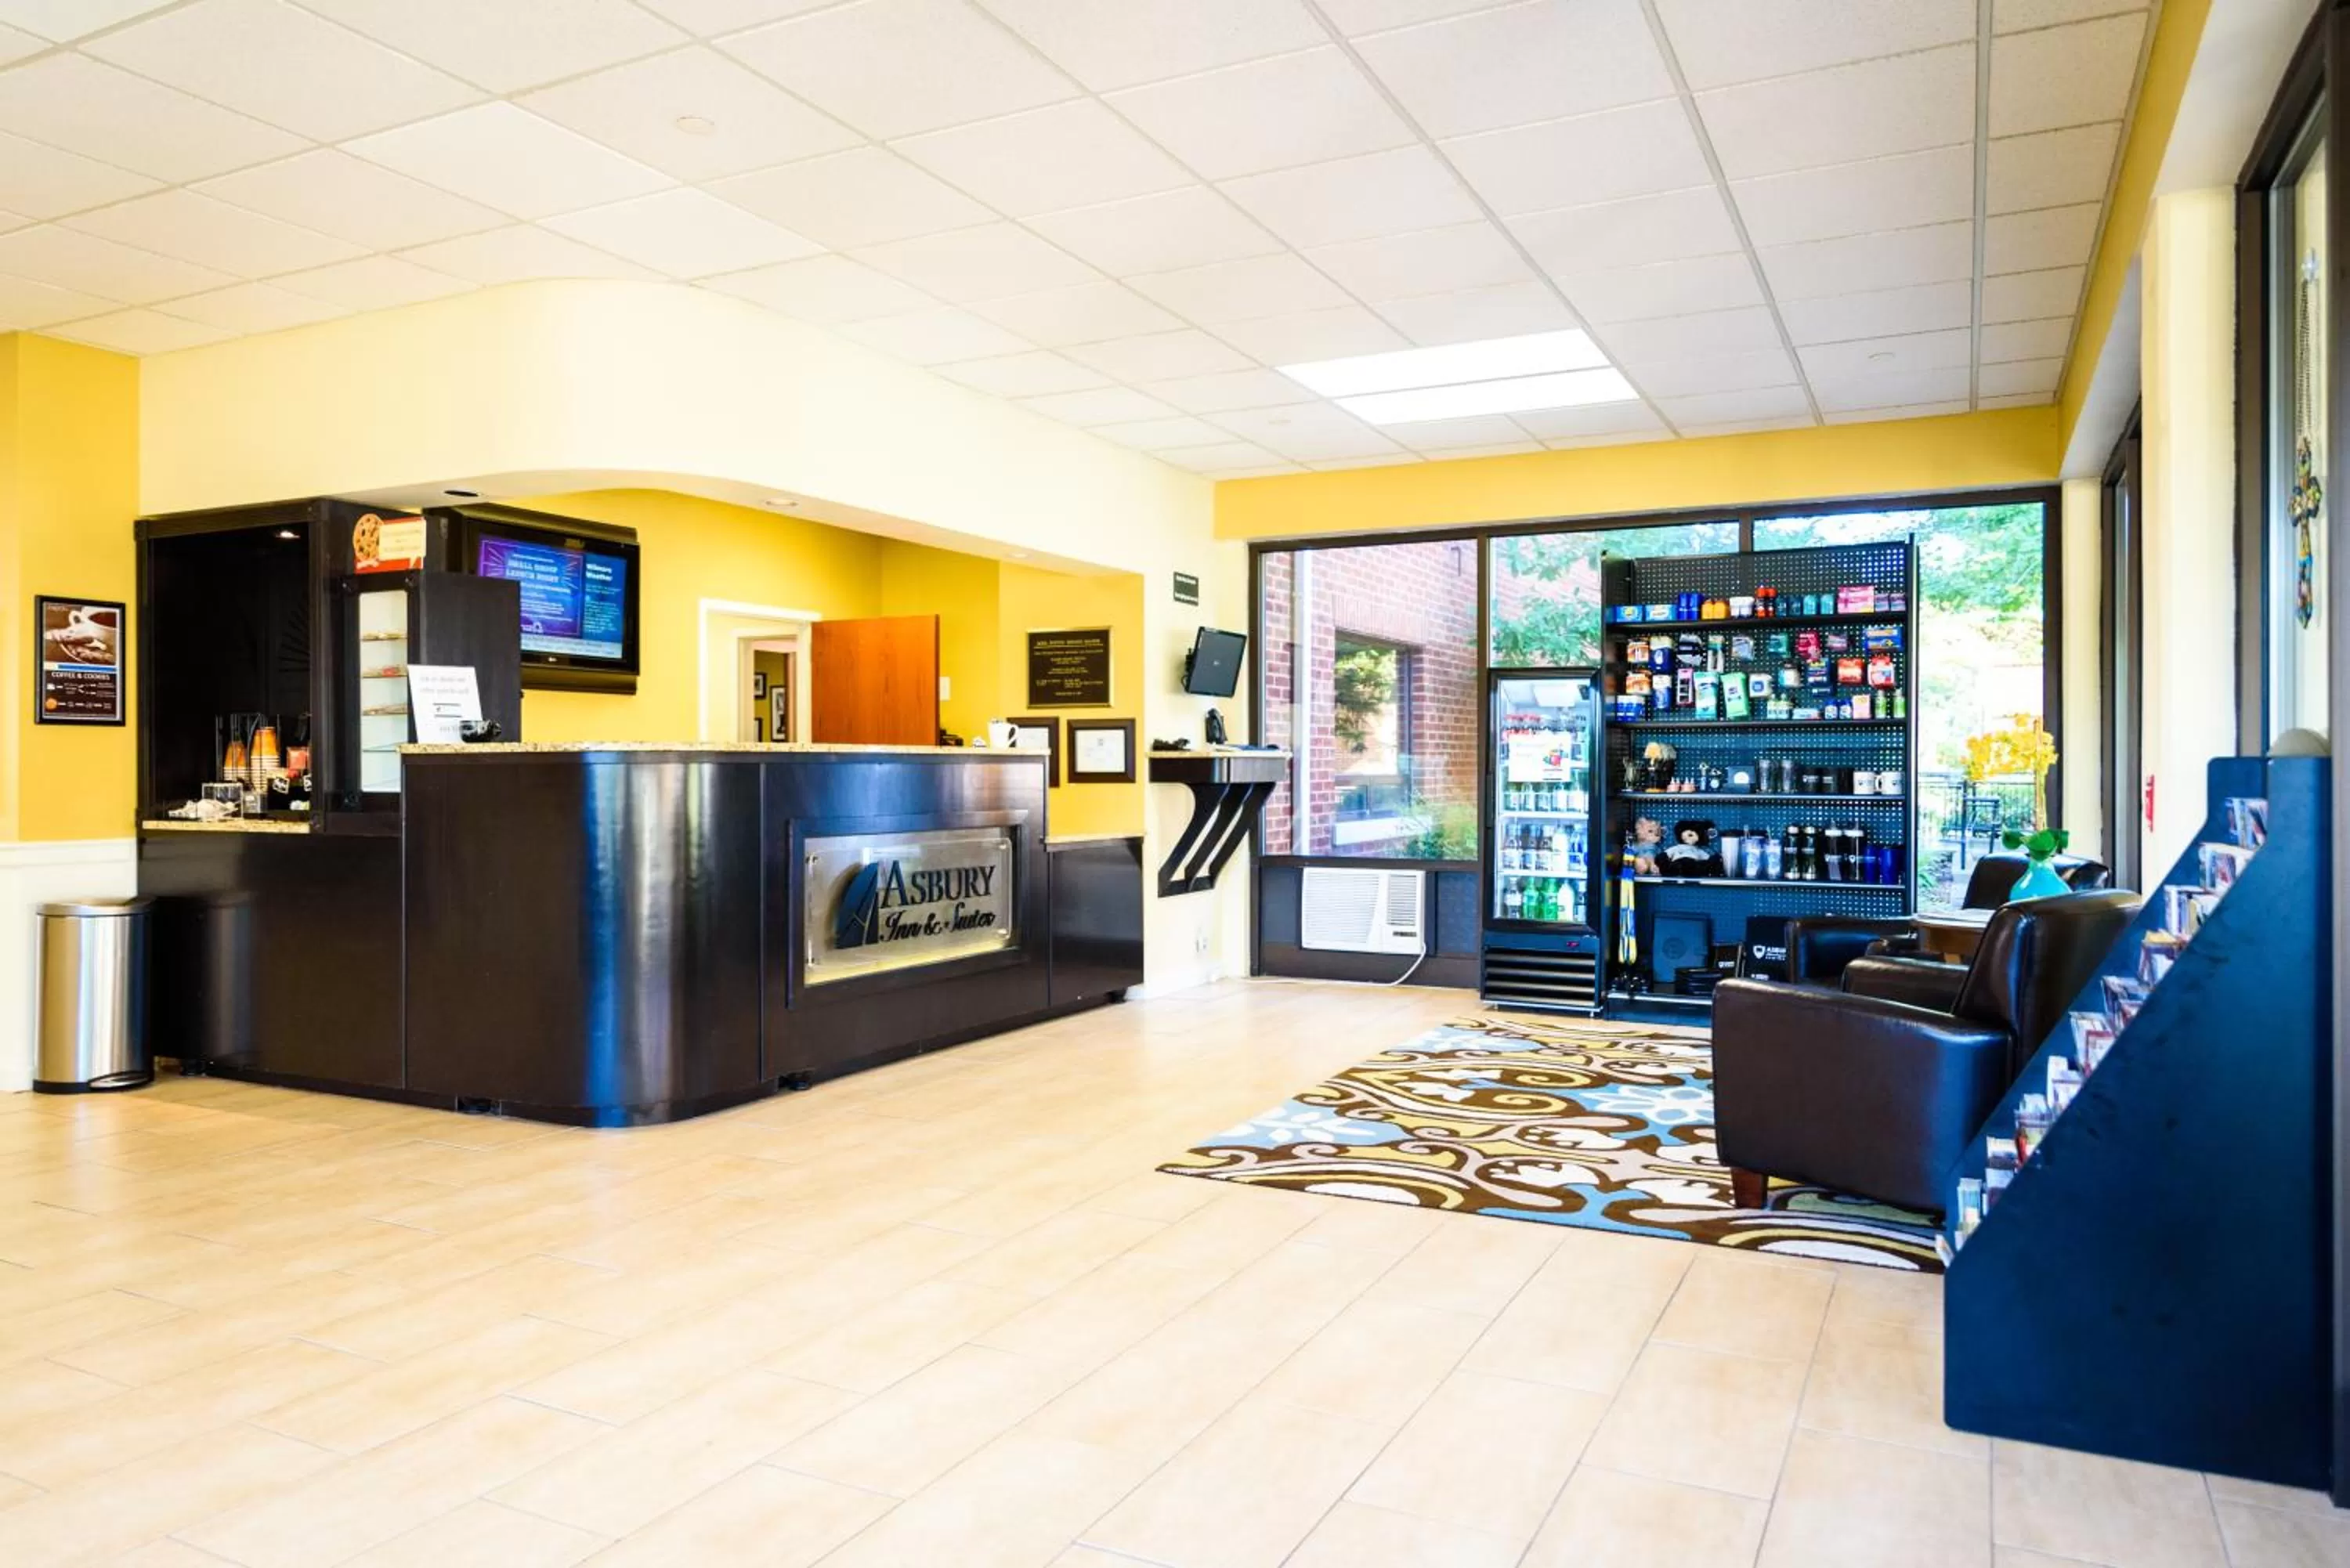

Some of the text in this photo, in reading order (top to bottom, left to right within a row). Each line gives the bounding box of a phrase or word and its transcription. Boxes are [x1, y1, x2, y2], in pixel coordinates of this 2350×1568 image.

[880, 859, 996, 909] ASBURY
[879, 902, 996, 941] Inn & Suites
